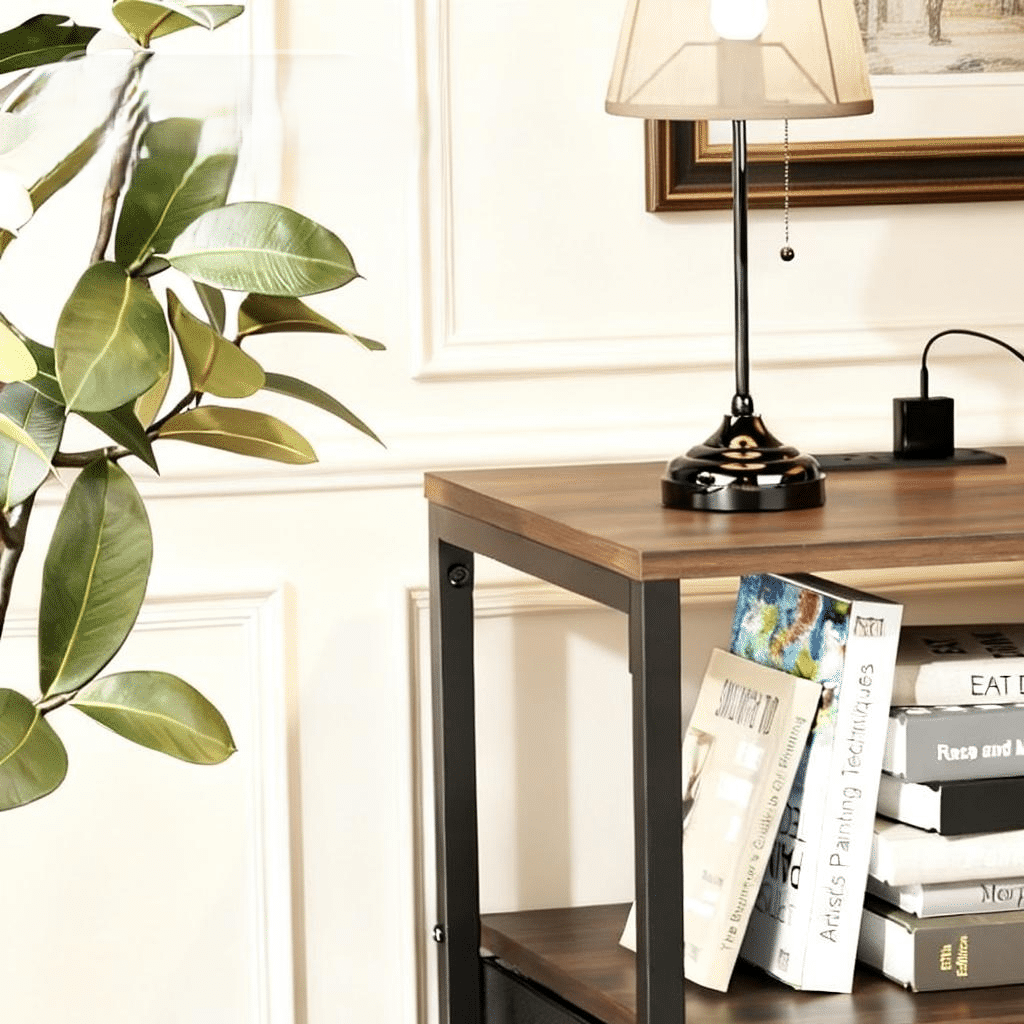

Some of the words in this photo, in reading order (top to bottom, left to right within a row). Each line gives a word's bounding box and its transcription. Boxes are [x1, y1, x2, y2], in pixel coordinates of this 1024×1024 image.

[971, 674, 1011, 696] EAT
[841, 664, 875, 777] Techniques
[982, 739, 1012, 758] and
[829, 787, 862, 867] Painting
